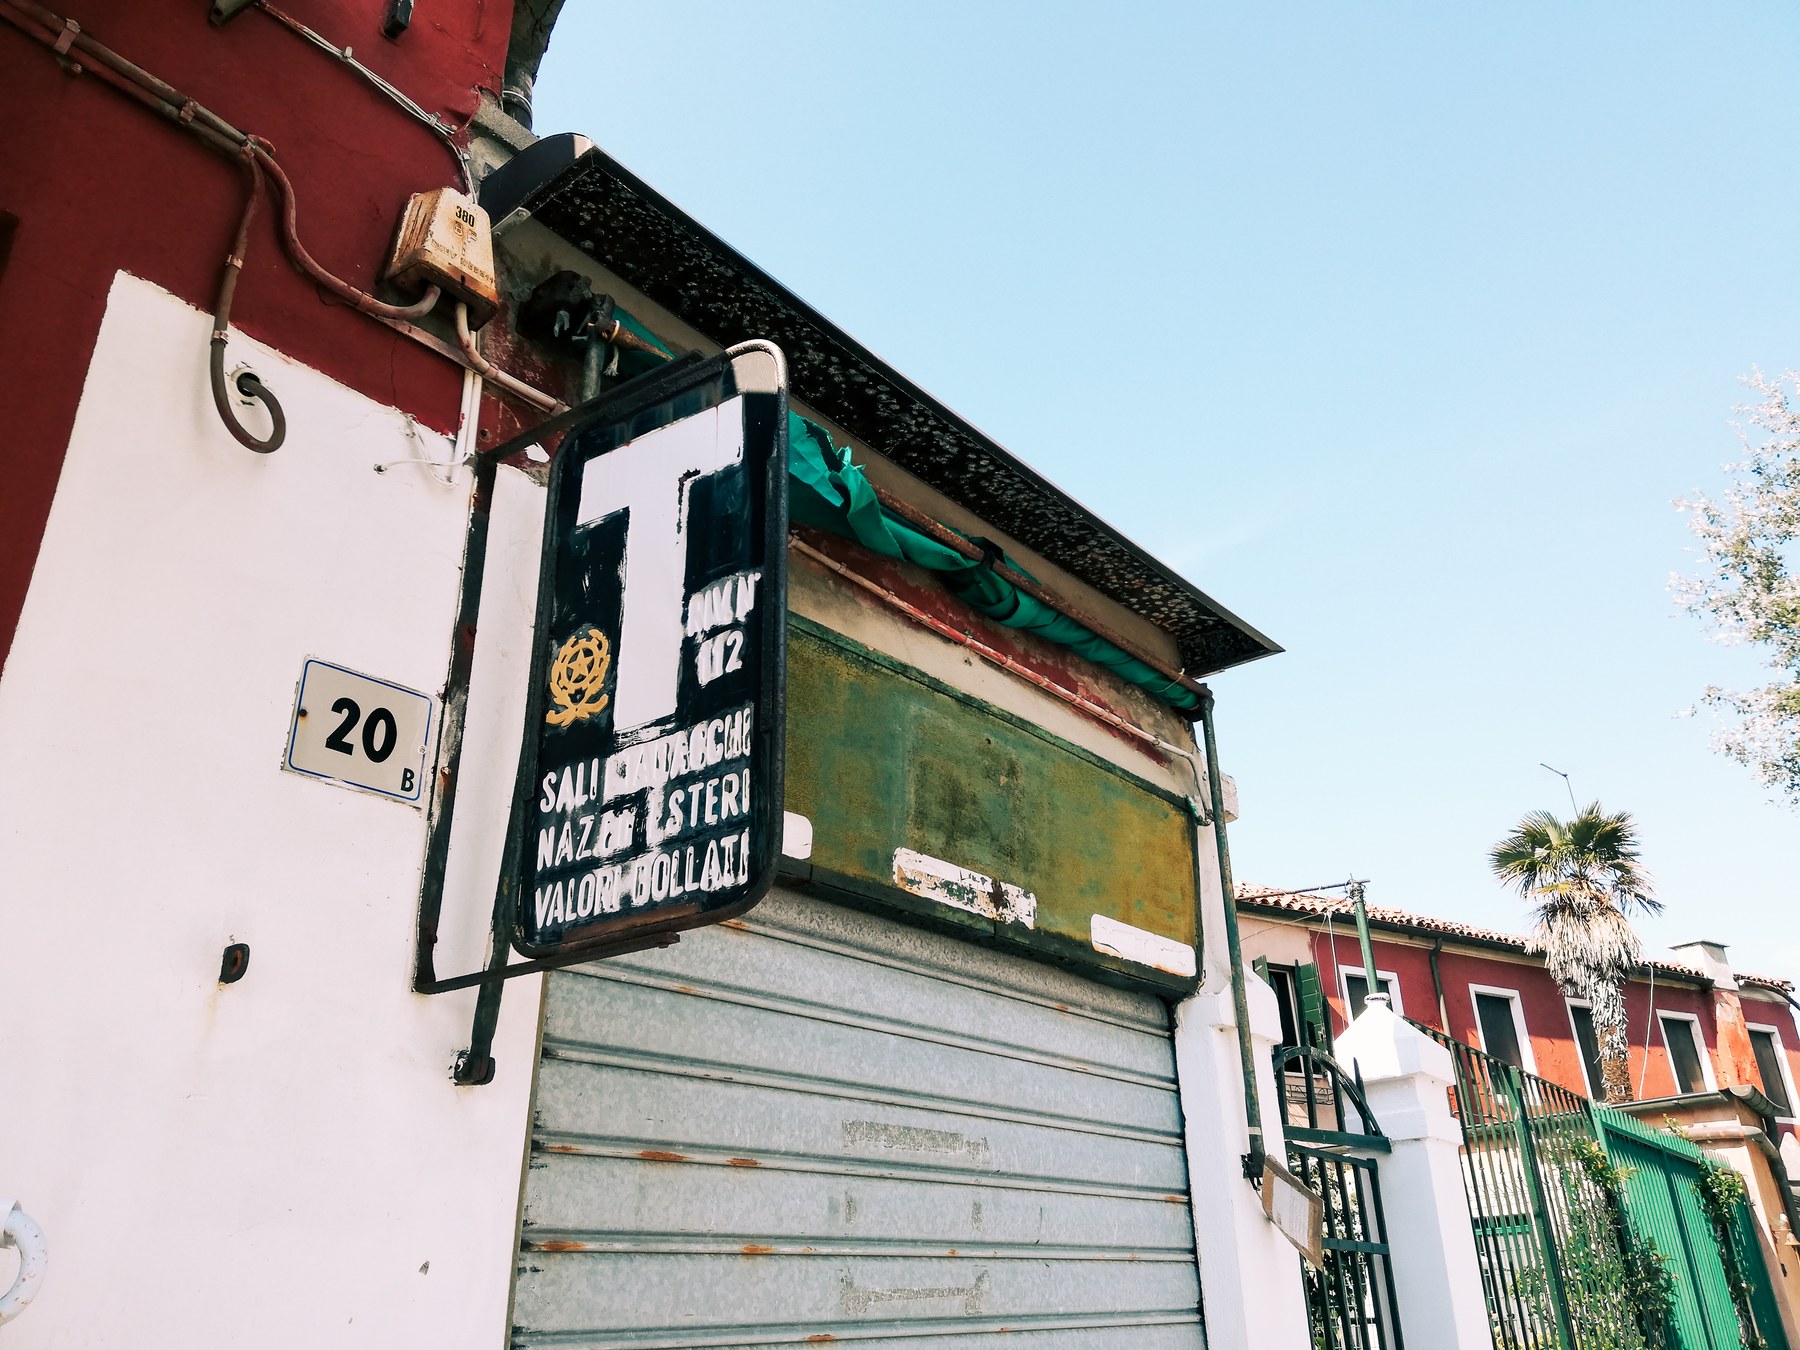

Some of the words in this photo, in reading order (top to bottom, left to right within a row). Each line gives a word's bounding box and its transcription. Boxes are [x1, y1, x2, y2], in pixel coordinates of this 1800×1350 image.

[455, 206, 475, 227] 380
[576, 394, 744, 732] T
[325, 697, 397, 763] 20
[401, 767, 415, 792] B
[540, 758, 599, 813] SALI
[646, 768, 750, 846] ESTERI
[535, 866, 622, 929] VALORI
[631, 829, 750, 907] BOLLATI
